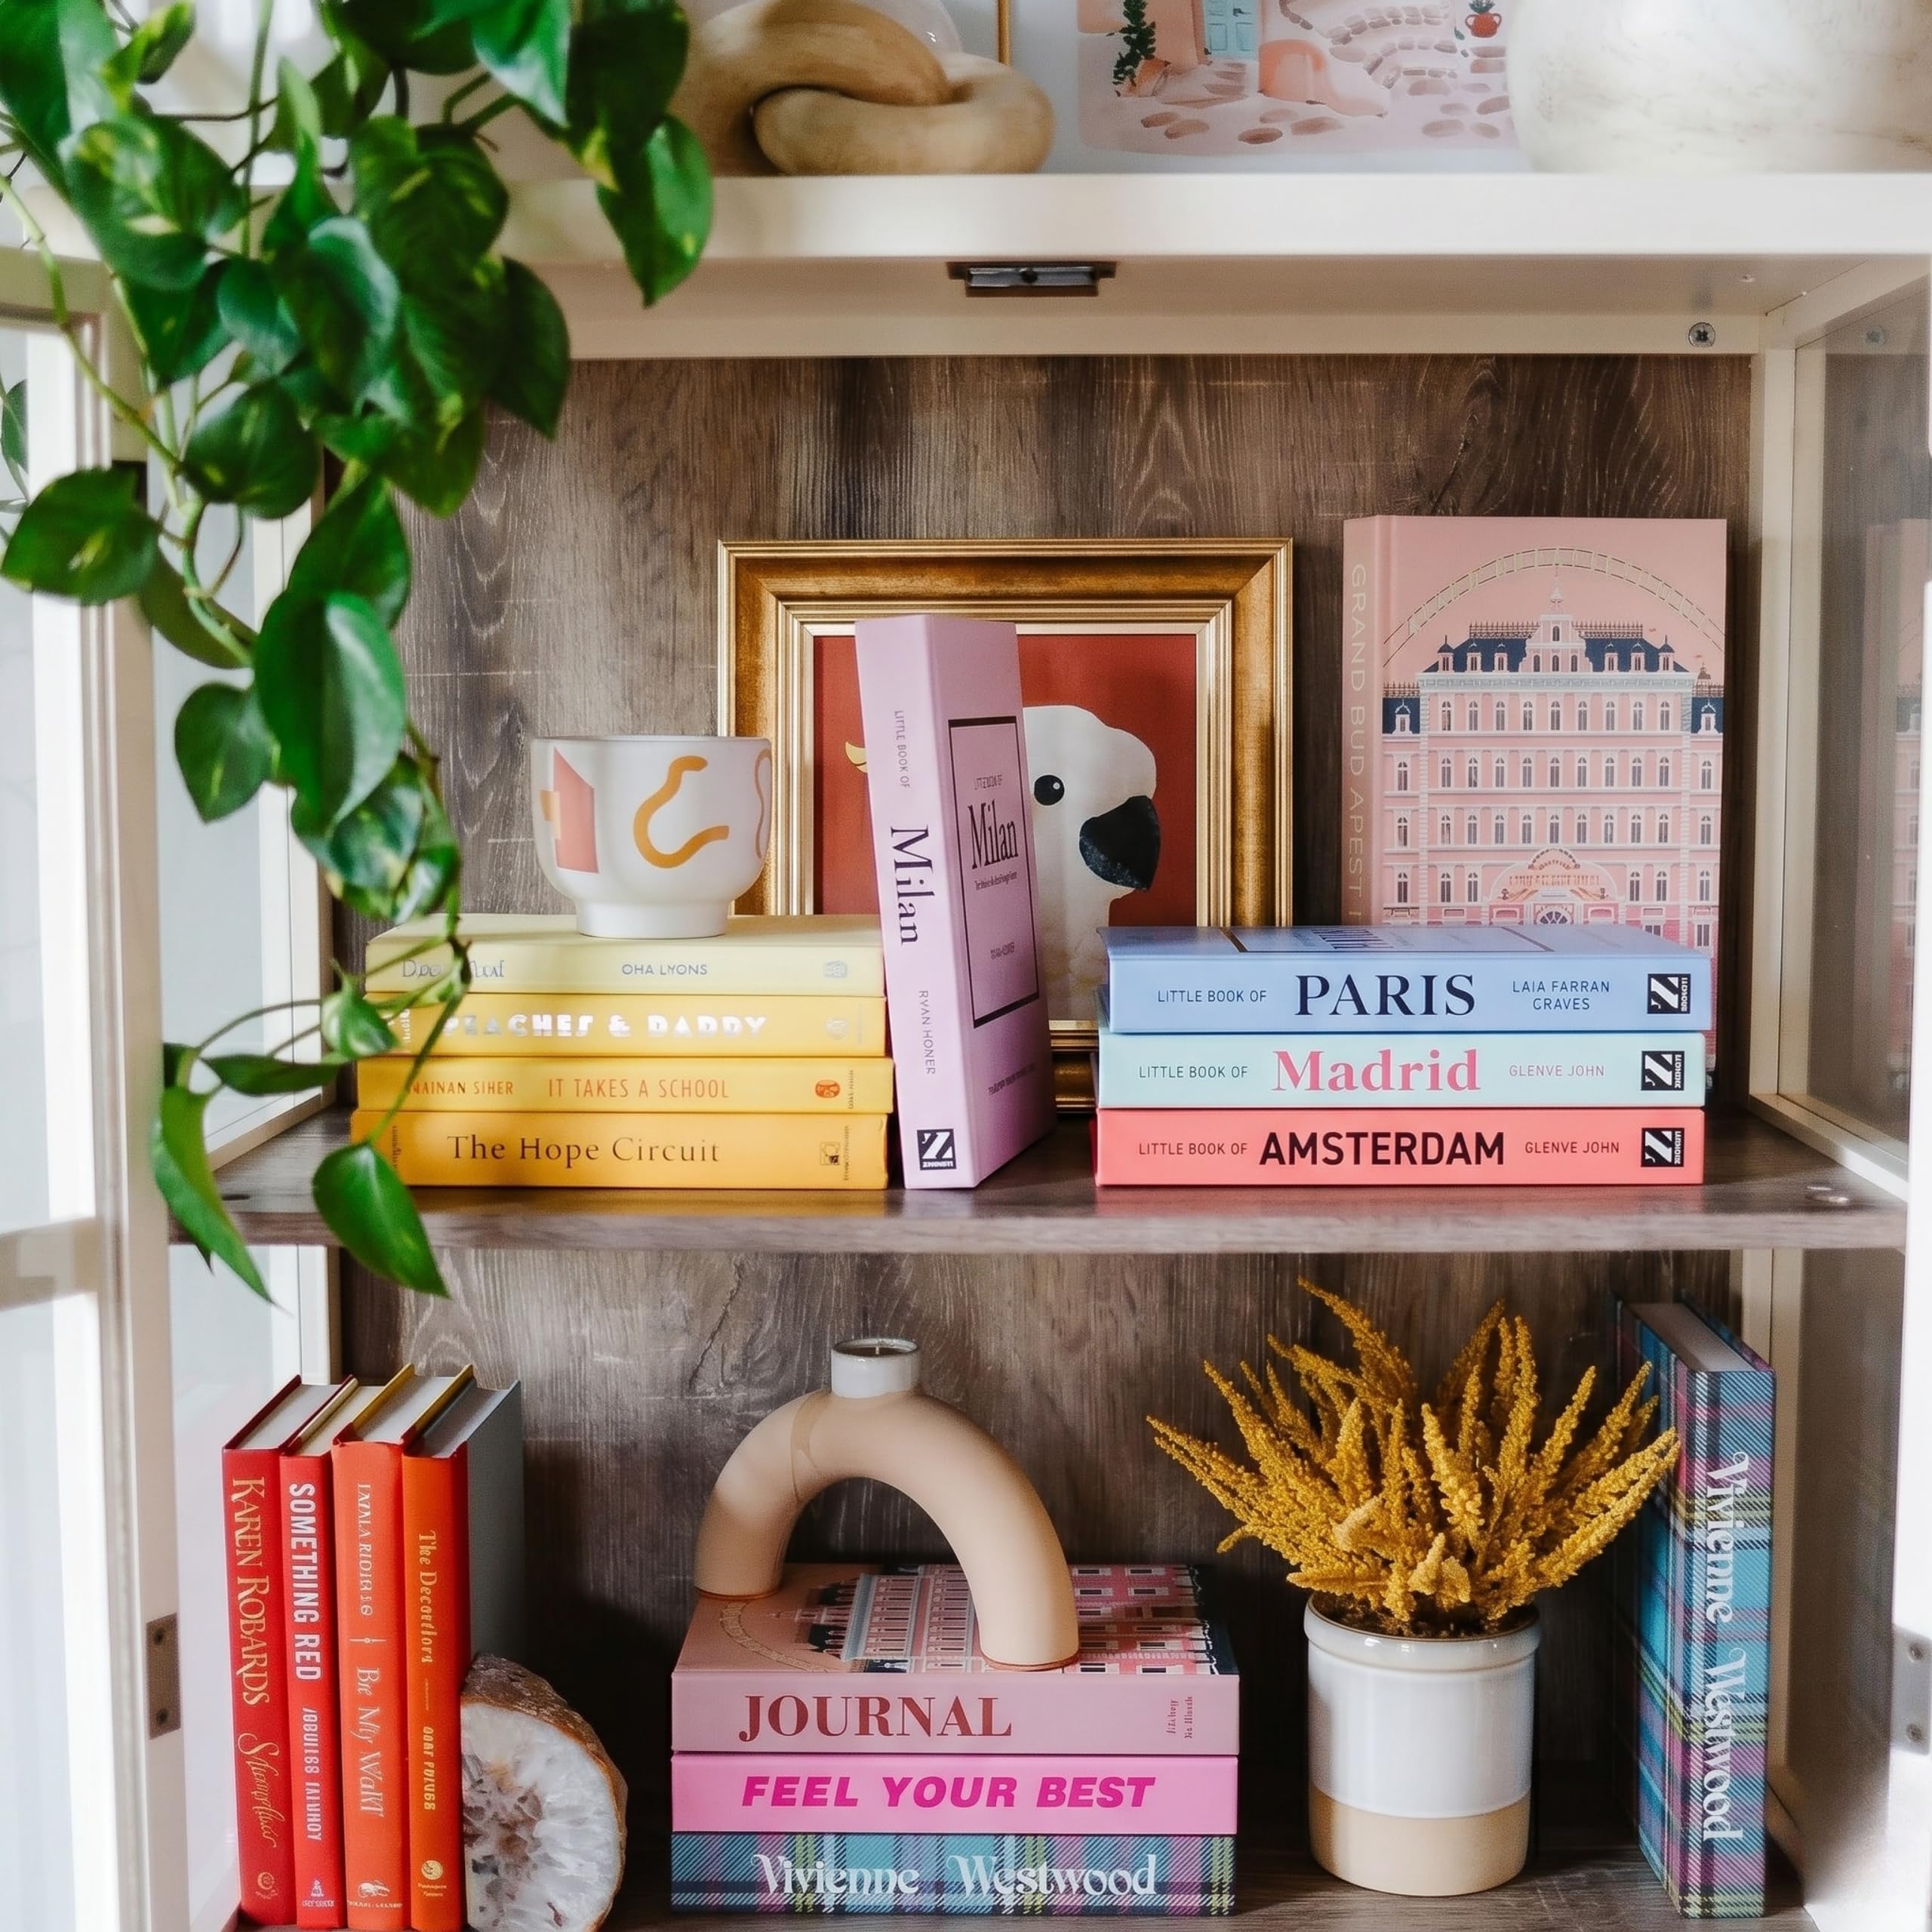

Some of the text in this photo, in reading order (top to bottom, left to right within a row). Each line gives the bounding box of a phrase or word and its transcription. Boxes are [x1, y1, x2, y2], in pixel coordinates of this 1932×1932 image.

[1350, 563, 1366, 692] GRAND
[894, 710, 911, 789] LITTLE BOOK OF
[1349, 705, 1365, 776] BUD
[968, 798, 1019, 870] Milan
[1348, 787, 1364, 897] APEST
[890, 824, 935, 946] Milan
[621, 964, 654, 976] OHA
[1512, 980, 1611, 993] LAIA FARRAN
[1157, 989, 1267, 1003] LITTLE BOOK OF
[1294, 974, 1475, 1016] PARIS
[648, 1014, 768, 1038] DADDY
[918, 990, 937, 1075] RYAN HONER
[473, 1081, 514, 1094] SIHER
[548, 1078, 730, 1099] IT TAKES A SCHOOL
[1139, 1066, 1248, 1078] LITTLE BOOK OF
[1271, 1048, 1481, 1092] Madrid
[1509, 1065, 1605, 1077] GLENVE JOHN
[447, 1134, 719, 1169] The Hope Circuit
[1138, 1143, 1247, 1155] LITTLE BOOK OF
[1259, 1131, 1504, 1166] AMSTERDAM
[1524, 1142, 1620, 1154] GLENVE JOHN
[232, 1476, 266, 1567] KAREN
[288, 1483, 320, 1624] SOMETHING
[418, 1531, 437, 1565] The
[235, 1575, 270, 1706] ROBARDS
[294, 1633, 321, 1681] RED
[1702, 1451, 1750, 1841] Vivienne Westwood
[740, 1694, 1012, 1743] JOURNAL
[742, 1775, 1156, 1808] FEEL YOUR BEST
[752, 1854, 1157, 1897] Vivienne Westwood
